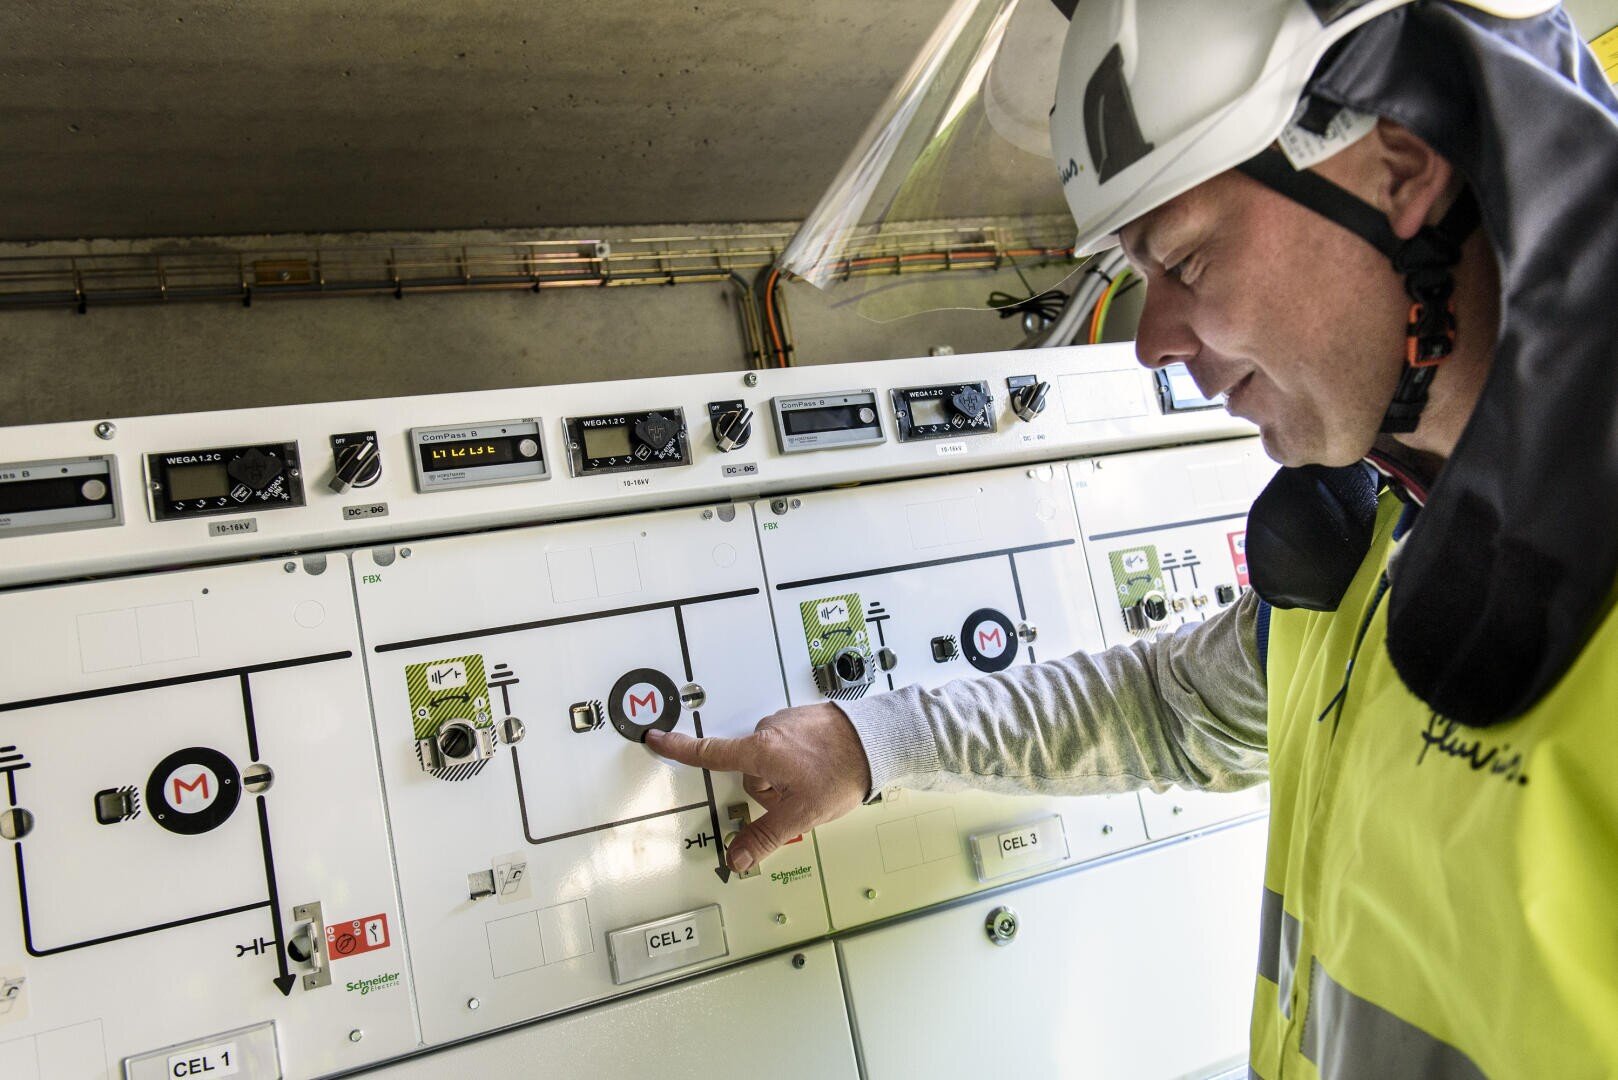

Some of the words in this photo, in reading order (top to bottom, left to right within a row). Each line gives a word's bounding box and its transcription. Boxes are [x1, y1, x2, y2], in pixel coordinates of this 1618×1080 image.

[781, 401, 817, 409] ComPass
[583, 419, 607, 427] WEGA
[422, 432, 467, 442] ComPass
[166, 455, 198, 465] WEGA
[198, 454, 212, 462] 1.2
[213, 453, 222, 461] C
[608, 457, 617, 465] L2
[624, 455, 633, 464] L3
[22, 470, 30, 478] B
[623, 478, 649, 487] 10-16kV
[175, 501, 185, 511] L1
[196, 499, 207, 508] L2
[217, 497, 228, 506] L3
[348, 508, 361, 516] DC
[216, 522, 250, 533] 10-16kV
[763, 521, 779, 531] FBX
[362, 574, 382, 584] FBX
[978, 627, 1003, 651] M
[629, 690, 657, 717] M
[172, 772, 210, 805] M
[1003, 836, 1028, 851] CEL
[1030, 833, 1038, 845] 3
[770, 865, 812, 881] Schneider
[650, 931, 682, 949] CEL
[685, 926, 694, 940] 2
[346, 972, 400, 992] Schneider
[173, 1056, 215, 1078] CEL
[221, 1051, 229, 1067] 1
